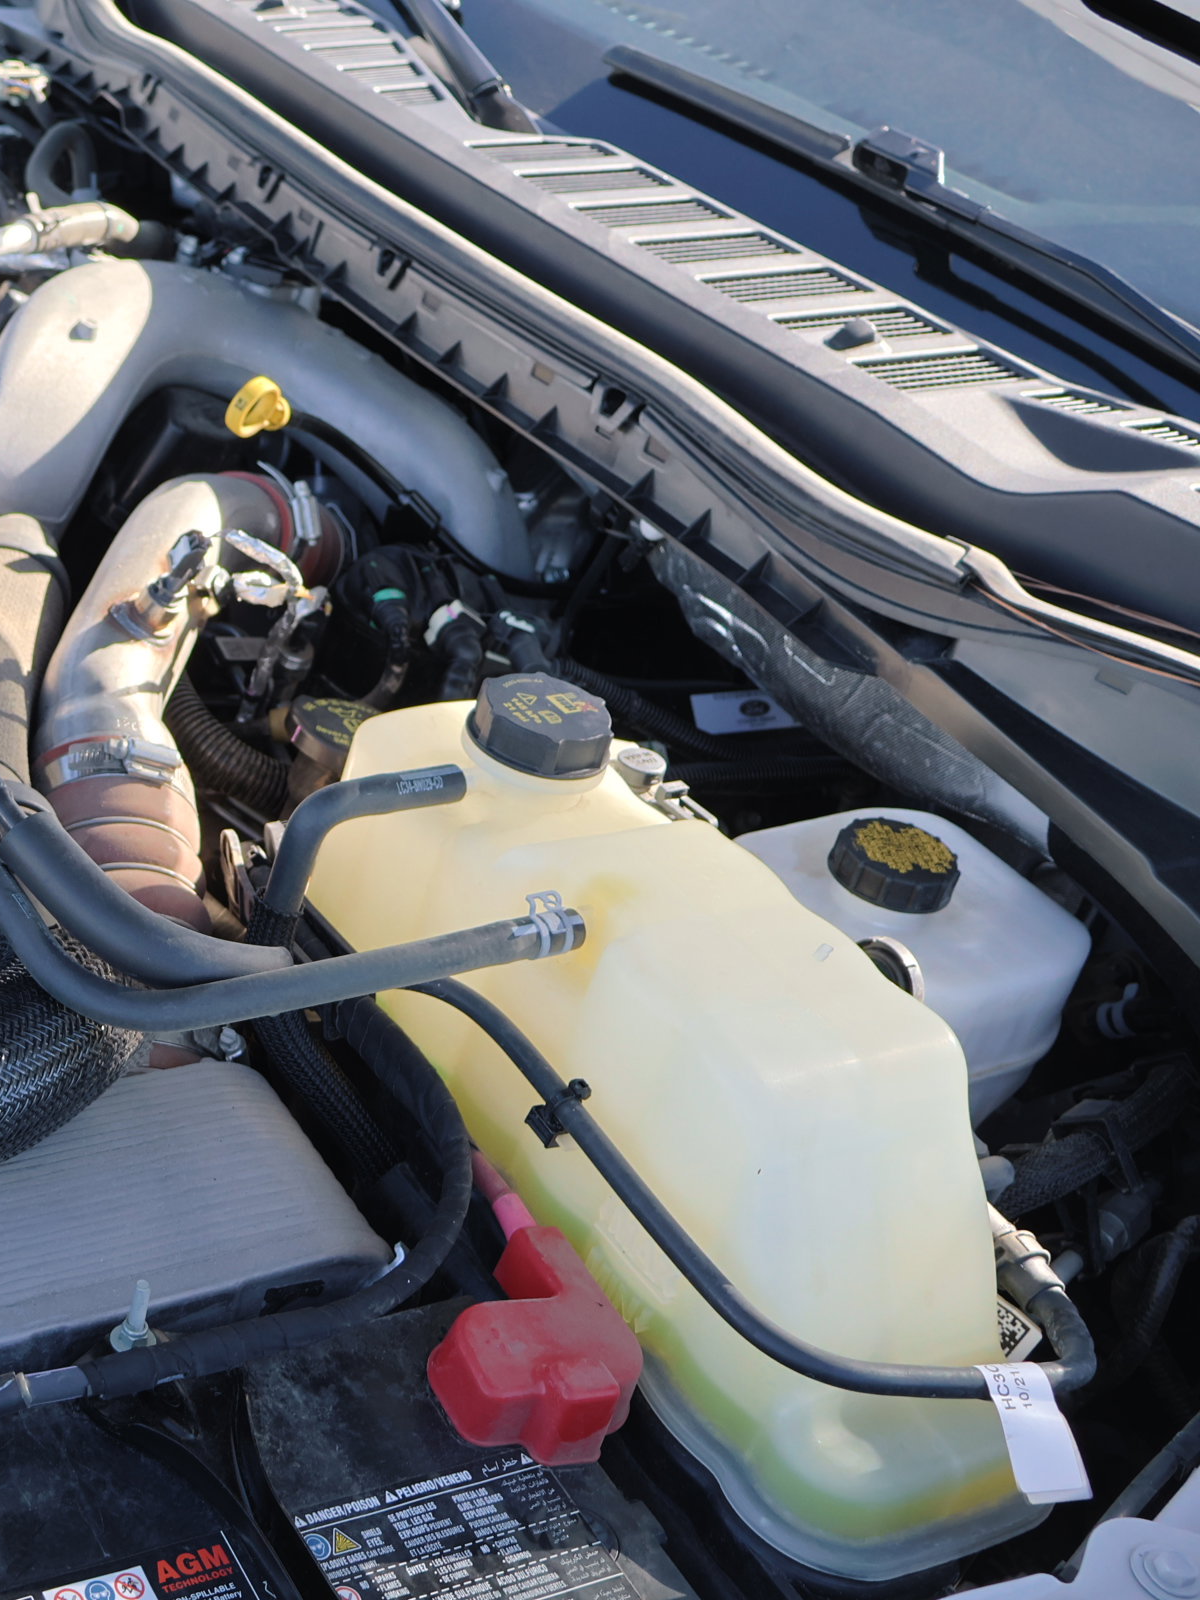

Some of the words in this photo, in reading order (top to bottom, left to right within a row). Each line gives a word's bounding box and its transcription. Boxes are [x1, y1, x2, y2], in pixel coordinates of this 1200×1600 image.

[396, 1471, 471, 1499] PELIGRO/VENENO
[452, 1491, 477, 1503] PROTEJA
[476, 1488, 488, 1497] LOS
[457, 1500, 477, 1512] OJOS.
[476, 1497, 488, 1507] LOS
[487, 1493, 503, 1504] GASES
[306, 1497, 380, 1524] DANGER/POISON
[396, 1505, 424, 1520] PROTÉGER
[423, 1502, 437, 1512] LES
[463, 1505, 497, 1520] EXPLOSIVOS
[393, 1520, 412, 1531] YEUX.
[410, 1516, 423, 1525] LES
[422, 1512, 435, 1522] GAZ
[399, 1524, 430, 1539] EXPLOSIFS
[429, 1518, 452, 1530] PEUVENT
[469, 1518, 490, 1528] PUEDEN
[488, 1512, 509, 1523] CAUSAR
[361, 1527, 382, 1539] SHIELD
[404, 1537, 426, 1548] CAUSER
[425, 1533, 436, 1542] DES
[436, 1525, 465, 1539] BLESSURES
[474, 1527, 492, 1538] DAÑOS
[366, 1537, 384, 1548] EYES.
[480, 1544, 490, 1553] NO
[321, 1557, 348, 1571] PLOSIVE
[347, 1552, 367, 1563] GASES
[377, 1545, 395, 1555] CAUSE
[409, 1549, 418, 1557] ET
[417, 1546, 426, 1555] LA
[432, 1558, 443, 1567] LES
[442, 1550, 472, 1564] ÉTINCELLES
[158, 1546, 228, 1582] AGM
[406, 1563, 428, 1576] ÉVITEZ
[437, 1566, 448, 1575] LES
[447, 1559, 473, 1572] FLAMMES
[162, 1568, 232, 1592] TECHNOLOGY
[442, 1575, 451, 1583] DE
[450, 1569, 469, 1580] FUMER
[496, 1574, 516, 1586] ÁCIDO
[515, 1564, 548, 1580] SULFÚRICO
[176, 1583, 235, 1600] ON-SPILLABLE
[359, 1580, 370, 1589] NO
[455, 1582, 492, 1599] SULFURIQUE
[503, 1584, 520, 1595] PUEDE
[518, 1578, 538, 1590] CAUSAR
[537, 1573, 559, 1584] CEGUERA
